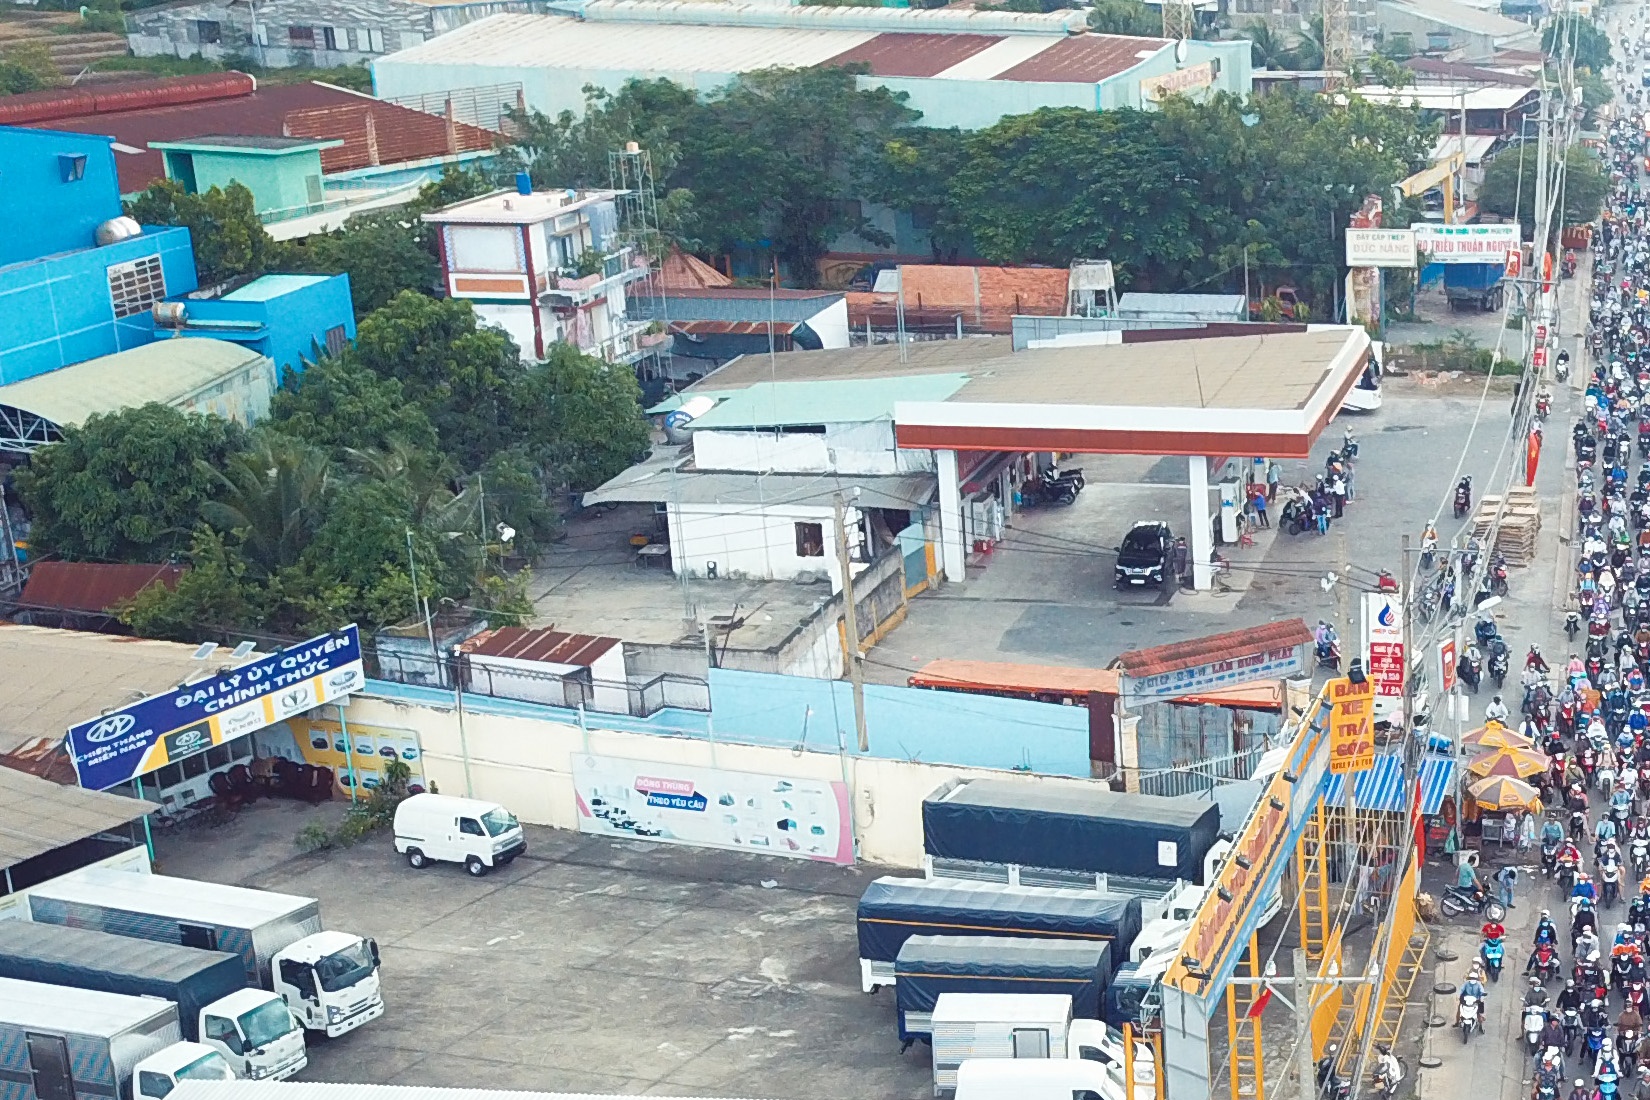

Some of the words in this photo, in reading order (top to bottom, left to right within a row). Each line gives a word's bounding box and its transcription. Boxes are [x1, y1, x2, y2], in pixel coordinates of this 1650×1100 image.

[175, 686, 215, 708] ĐẠI
[219, 674, 242, 693] LÝ
[247, 663, 276, 681] ỦY
[204, 680, 271, 713] CHÍNH
[273, 658, 330, 686] THỨC
[1341, 700, 1363, 716] XE
[1337, 718, 1369, 738] TRẢ
[648, 795, 670, 806] THEO
